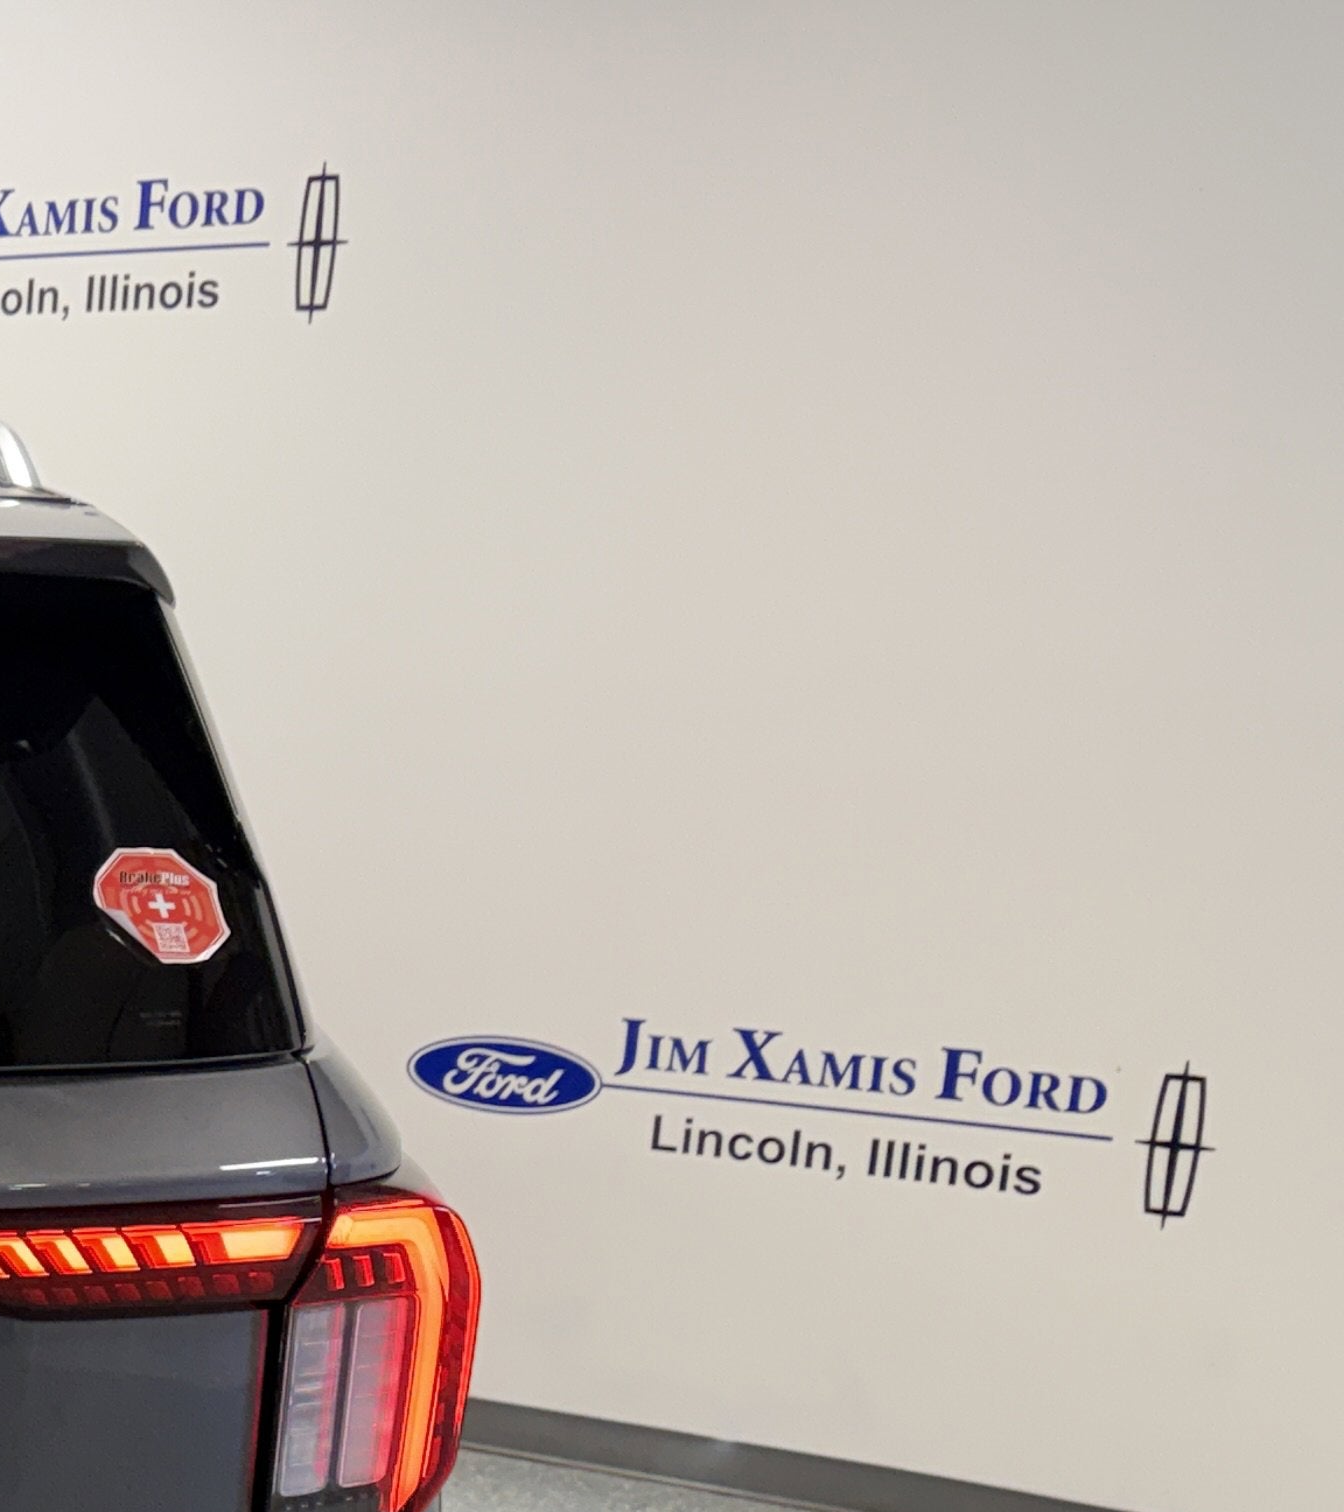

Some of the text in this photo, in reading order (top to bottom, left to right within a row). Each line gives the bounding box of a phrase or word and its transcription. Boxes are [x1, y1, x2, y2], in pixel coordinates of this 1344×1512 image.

[133, 178, 265, 231] FORD
[85, 270, 220, 313] Illinois
[442, 1049, 560, 1106] Ford
[613, 1017, 1108, 1115] JIM XAMIS FORD
[650, 1115, 1043, 1197] Lincoln, Illinois
